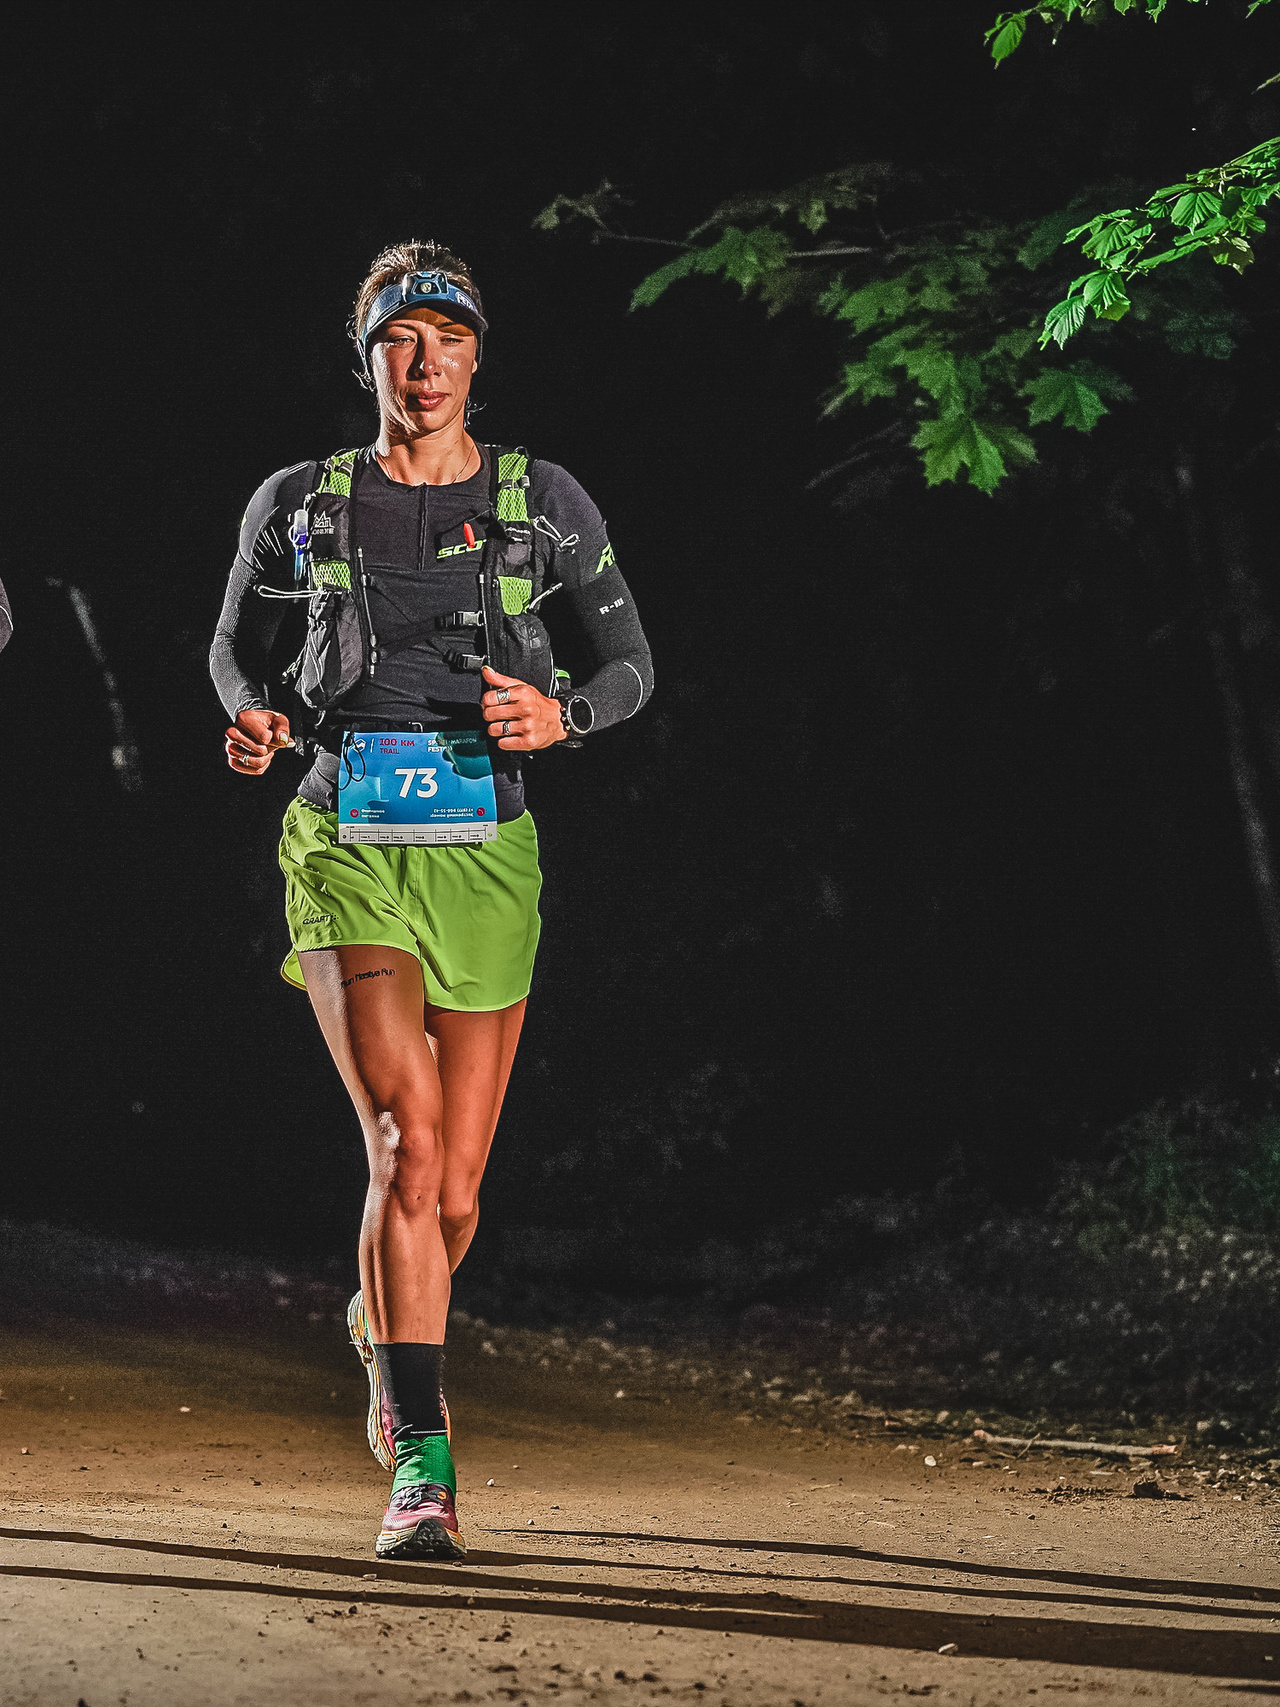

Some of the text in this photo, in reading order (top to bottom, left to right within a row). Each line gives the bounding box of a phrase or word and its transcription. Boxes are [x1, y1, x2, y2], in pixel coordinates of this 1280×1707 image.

[436, 538, 487, 559] SCO
[380, 738, 397, 746] 100
[394, 767, 439, 799] 73
